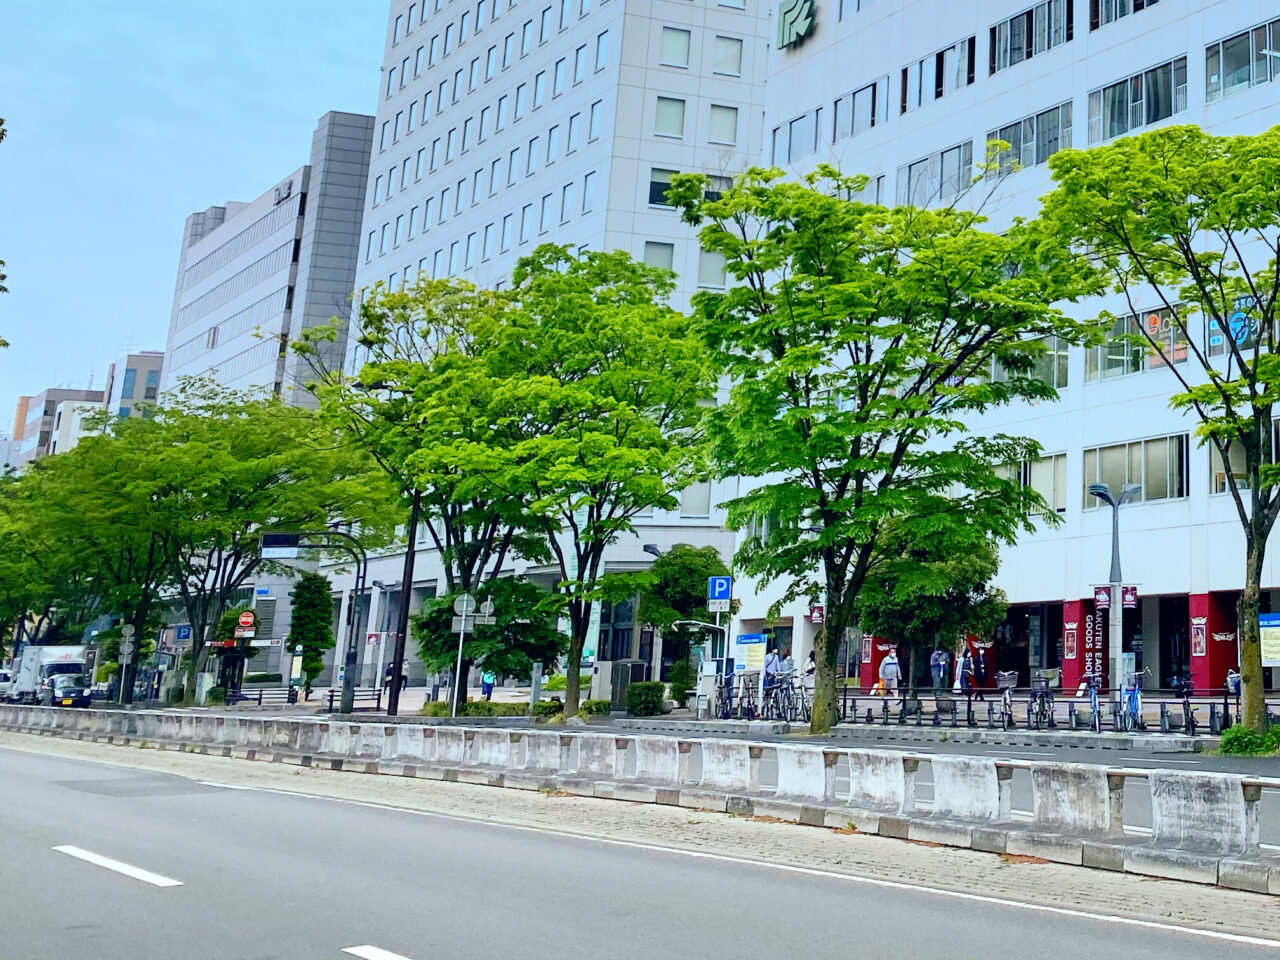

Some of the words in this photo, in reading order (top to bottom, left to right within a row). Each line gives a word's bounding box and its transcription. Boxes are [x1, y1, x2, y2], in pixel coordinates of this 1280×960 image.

[715, 579, 728, 596] P
[1085, 614, 1094, 649] GOODS
[1094, 606, 1104, 649] AKUTEN
